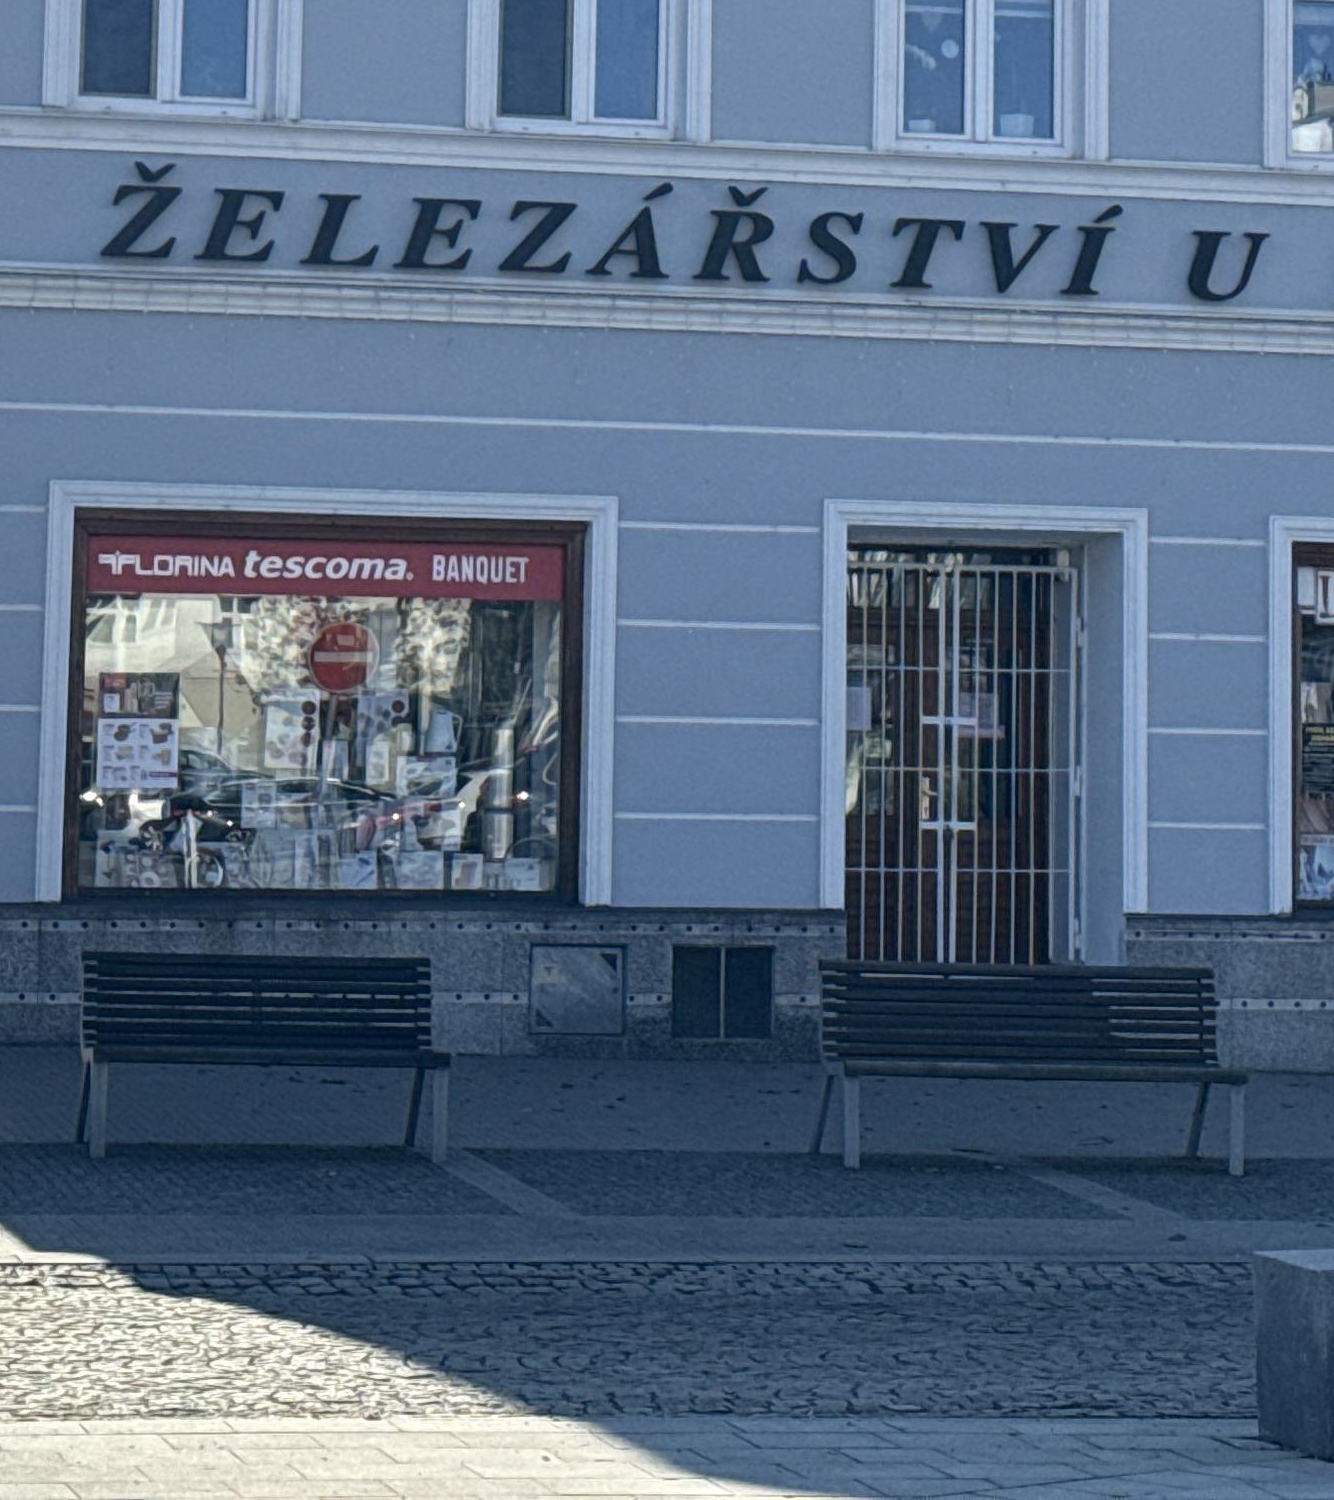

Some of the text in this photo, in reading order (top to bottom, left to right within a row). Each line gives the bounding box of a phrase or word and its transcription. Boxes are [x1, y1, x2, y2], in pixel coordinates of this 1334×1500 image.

[100, 160, 1125, 297] ŽELEZÁŘSTVÍ
[1186, 230, 1272, 301] U
[98, 549, 236, 578] FLORINA
[432, 554, 530, 585] BANQUET
